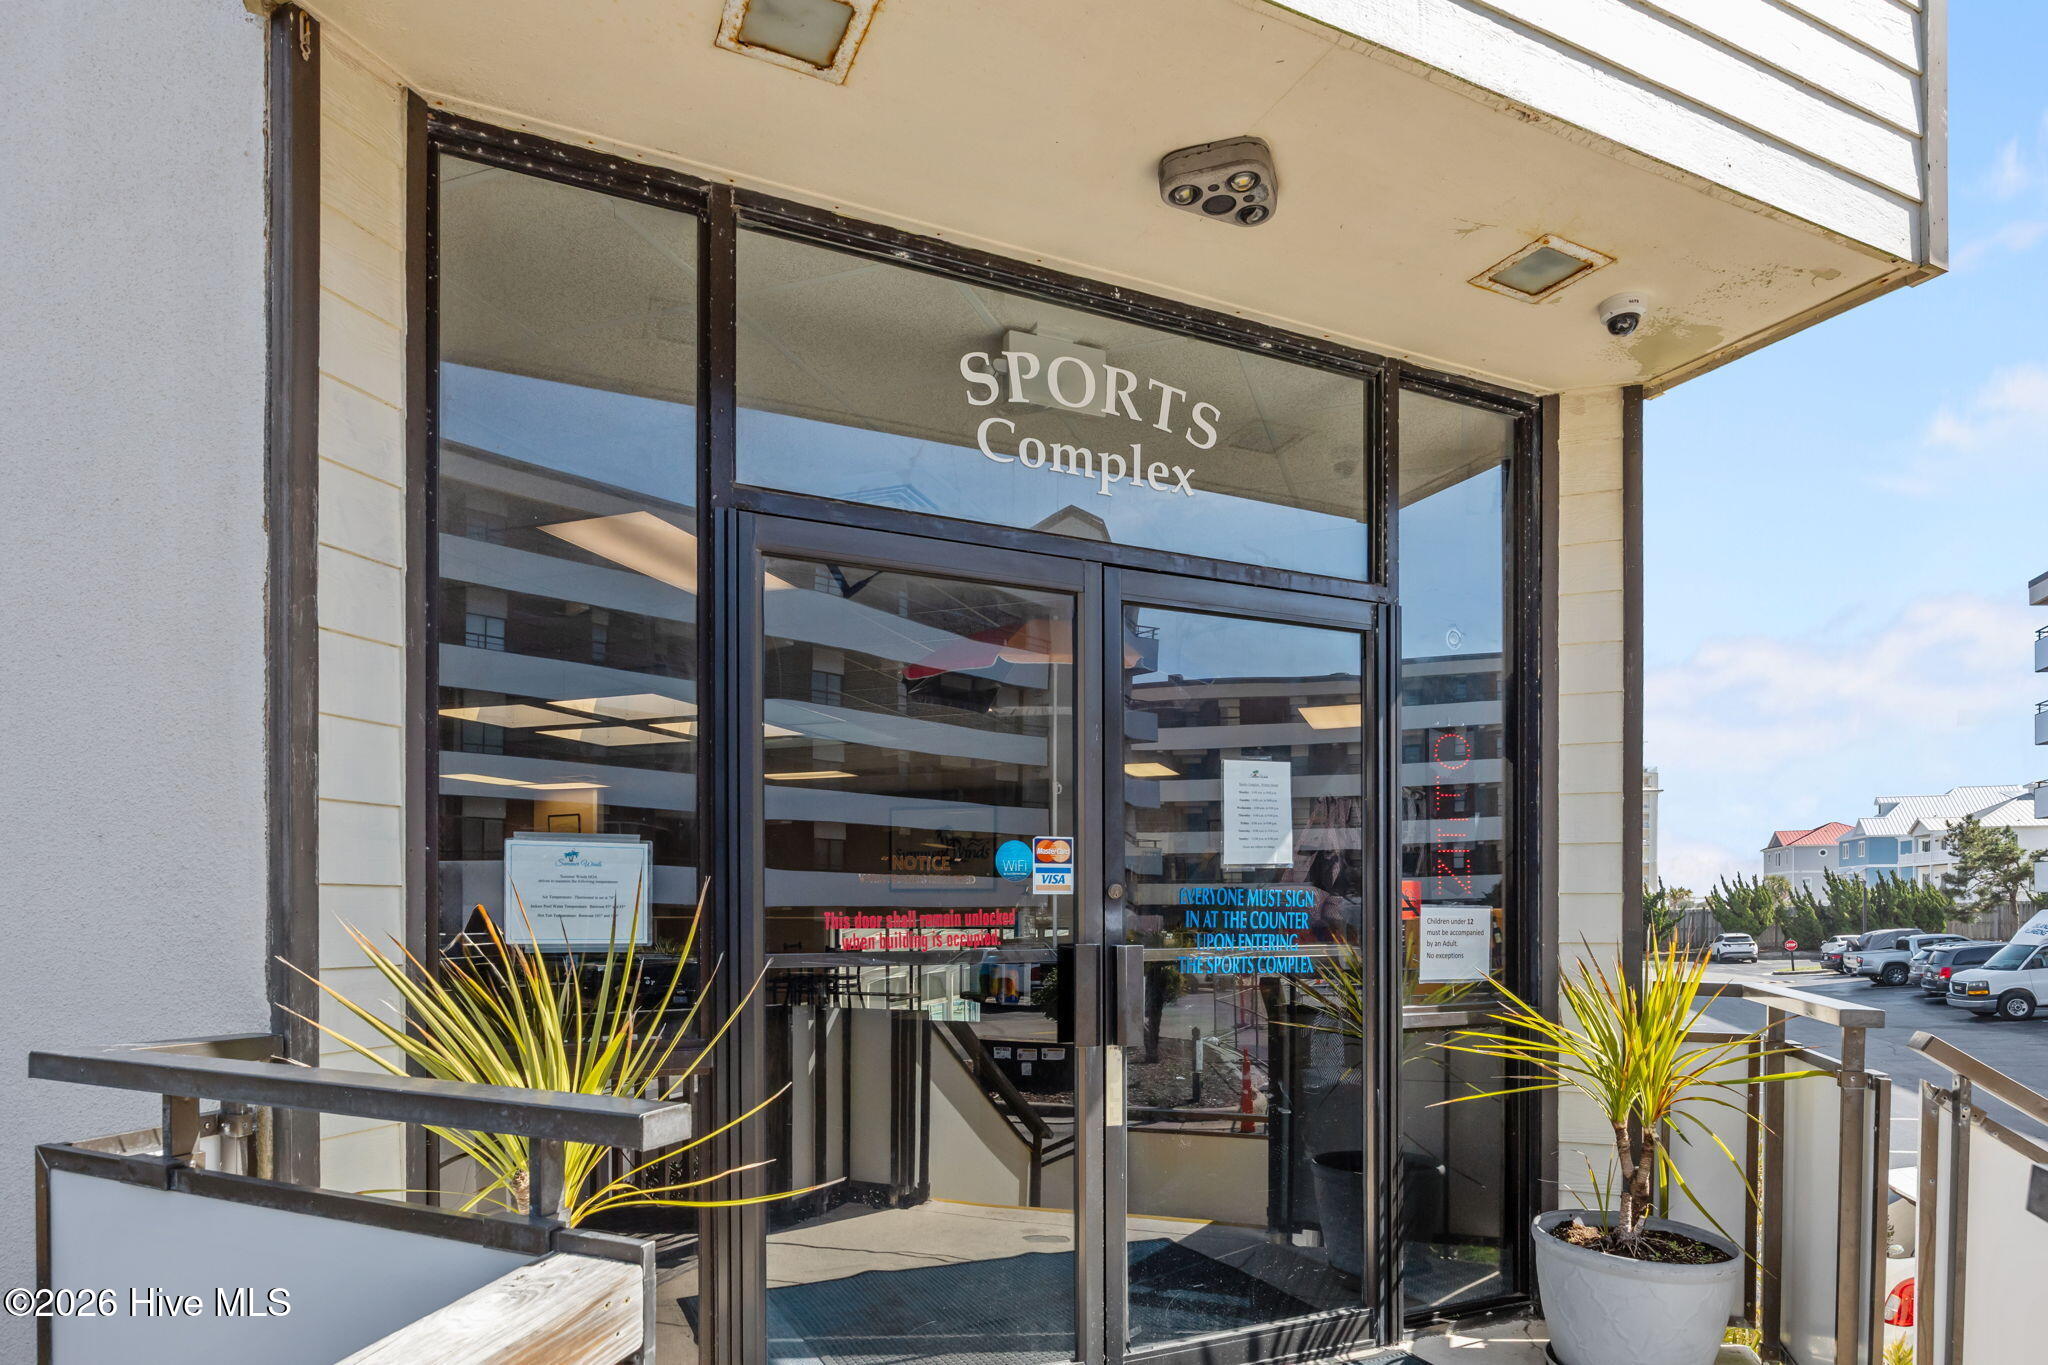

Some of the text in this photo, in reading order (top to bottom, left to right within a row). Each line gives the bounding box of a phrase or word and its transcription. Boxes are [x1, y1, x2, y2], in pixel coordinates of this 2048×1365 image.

[960, 351, 1221, 449] SPORTS
[977, 418, 1195, 496] Complex
[1036, 847, 1071, 855] MasterCard
[1003, 859, 1028, 872] WiFi
[1042, 874, 1066, 885] VISA
[1179, 887, 1315, 908] EVERYONE MUST SIGN
[824, 908, 1016, 930] This door shall remain unlocked
[1185, 910, 1309, 930] IN AT THE COUNTER
[842, 929, 1002, 952] when building is occupied.
[1195, 932, 1298, 952] UPON ENTERING
[1449, 929, 1485, 937] accompanied
[1178, 956, 1315, 974] THE SPORTS COMPLEX
[1435, 952, 1464, 960] exceptions
